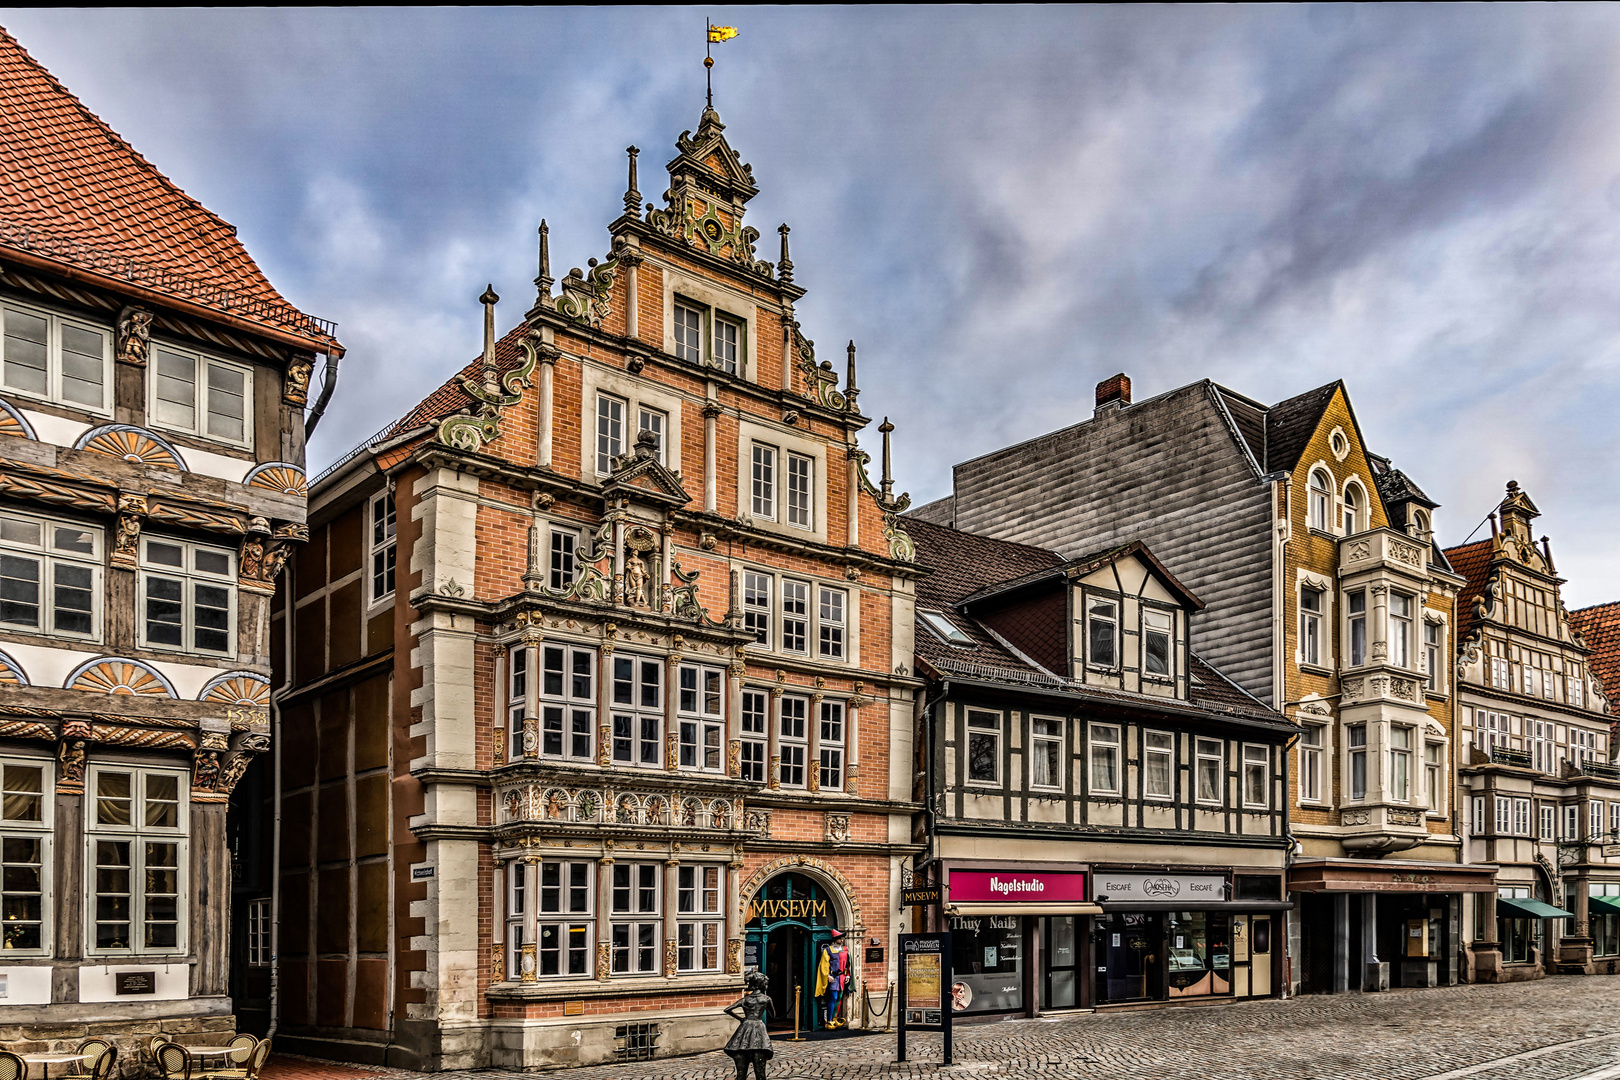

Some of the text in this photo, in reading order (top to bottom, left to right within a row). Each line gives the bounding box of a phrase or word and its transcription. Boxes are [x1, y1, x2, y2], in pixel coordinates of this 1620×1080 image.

[226, 709, 267, 725] 1558
[990, 877, 1044, 895] Nagelstudio
[905, 890, 939, 902] MVSEVM
[752, 899, 827, 918] MVSEVM
[899, 922, 905, 933] 9
[989, 915, 1017, 930] Nails
